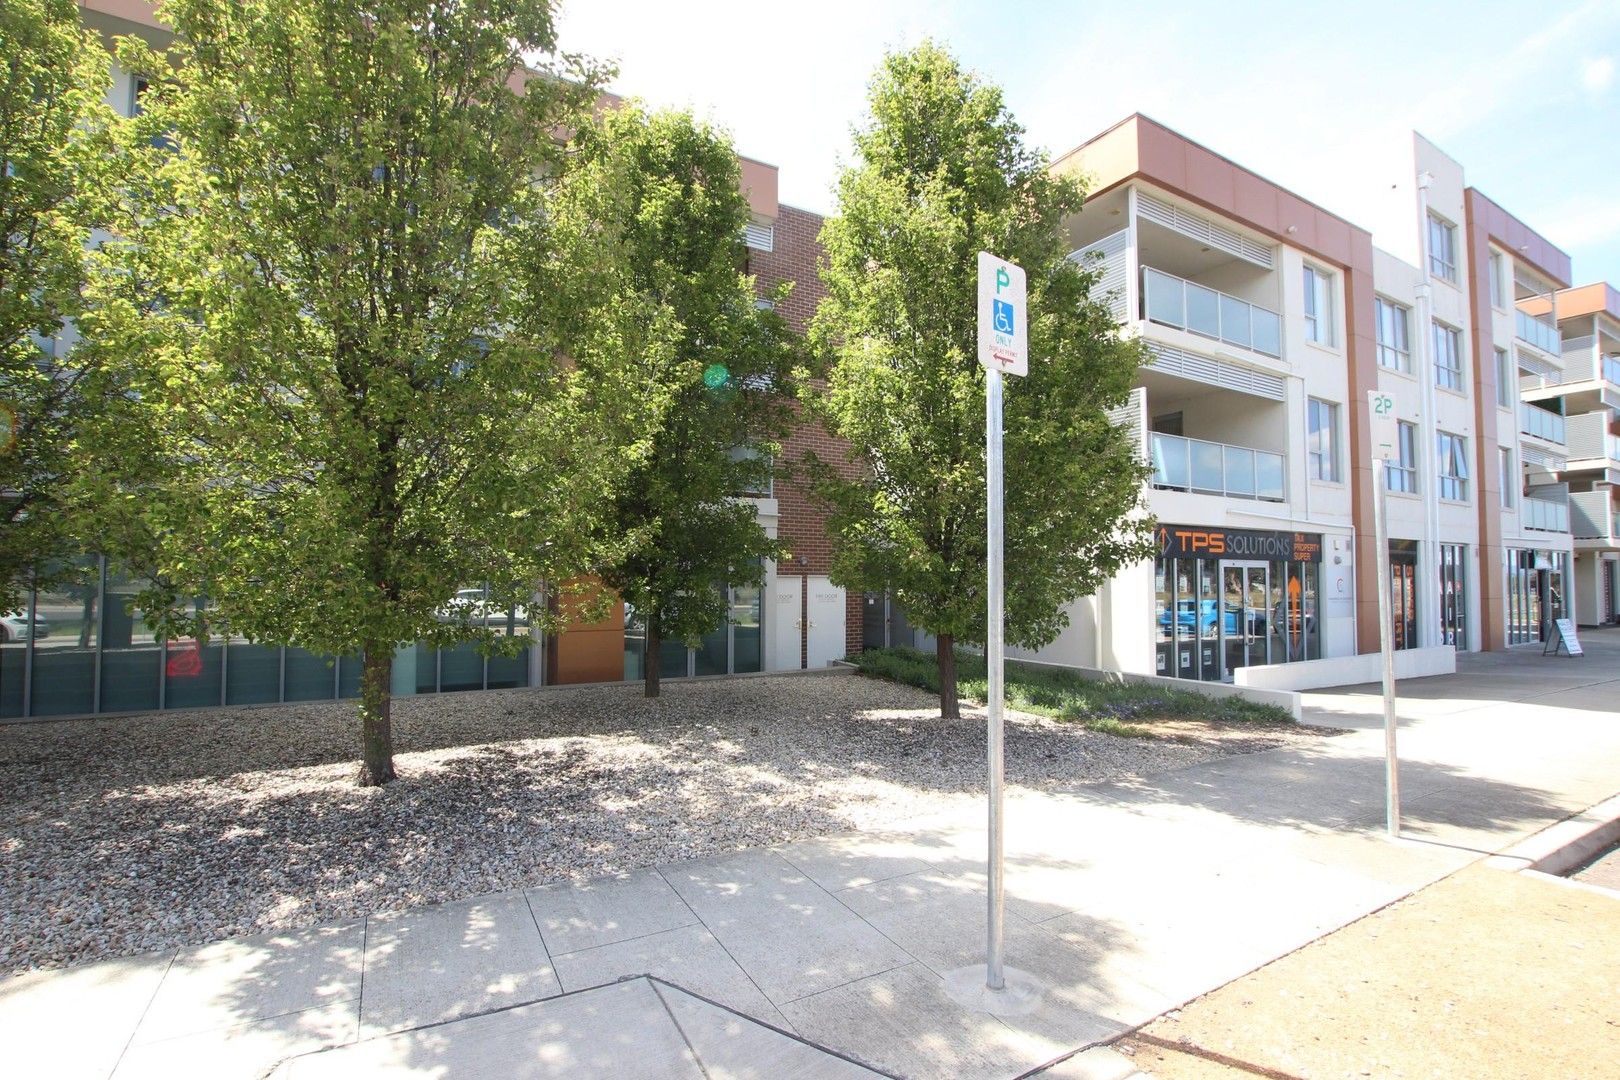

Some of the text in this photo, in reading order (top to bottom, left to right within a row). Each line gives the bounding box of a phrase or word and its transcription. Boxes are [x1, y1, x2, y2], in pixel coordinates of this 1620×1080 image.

[996, 267, 1010, 295] P
[995, 334, 1012, 347] ONLY
[1374, 396, 1392, 414] 2P
[1175, 531, 1290, 556] TPS SOLUTIONS
[1294, 543, 1319, 552] PROPERTY
[1294, 552, 1311, 561] SUPER
